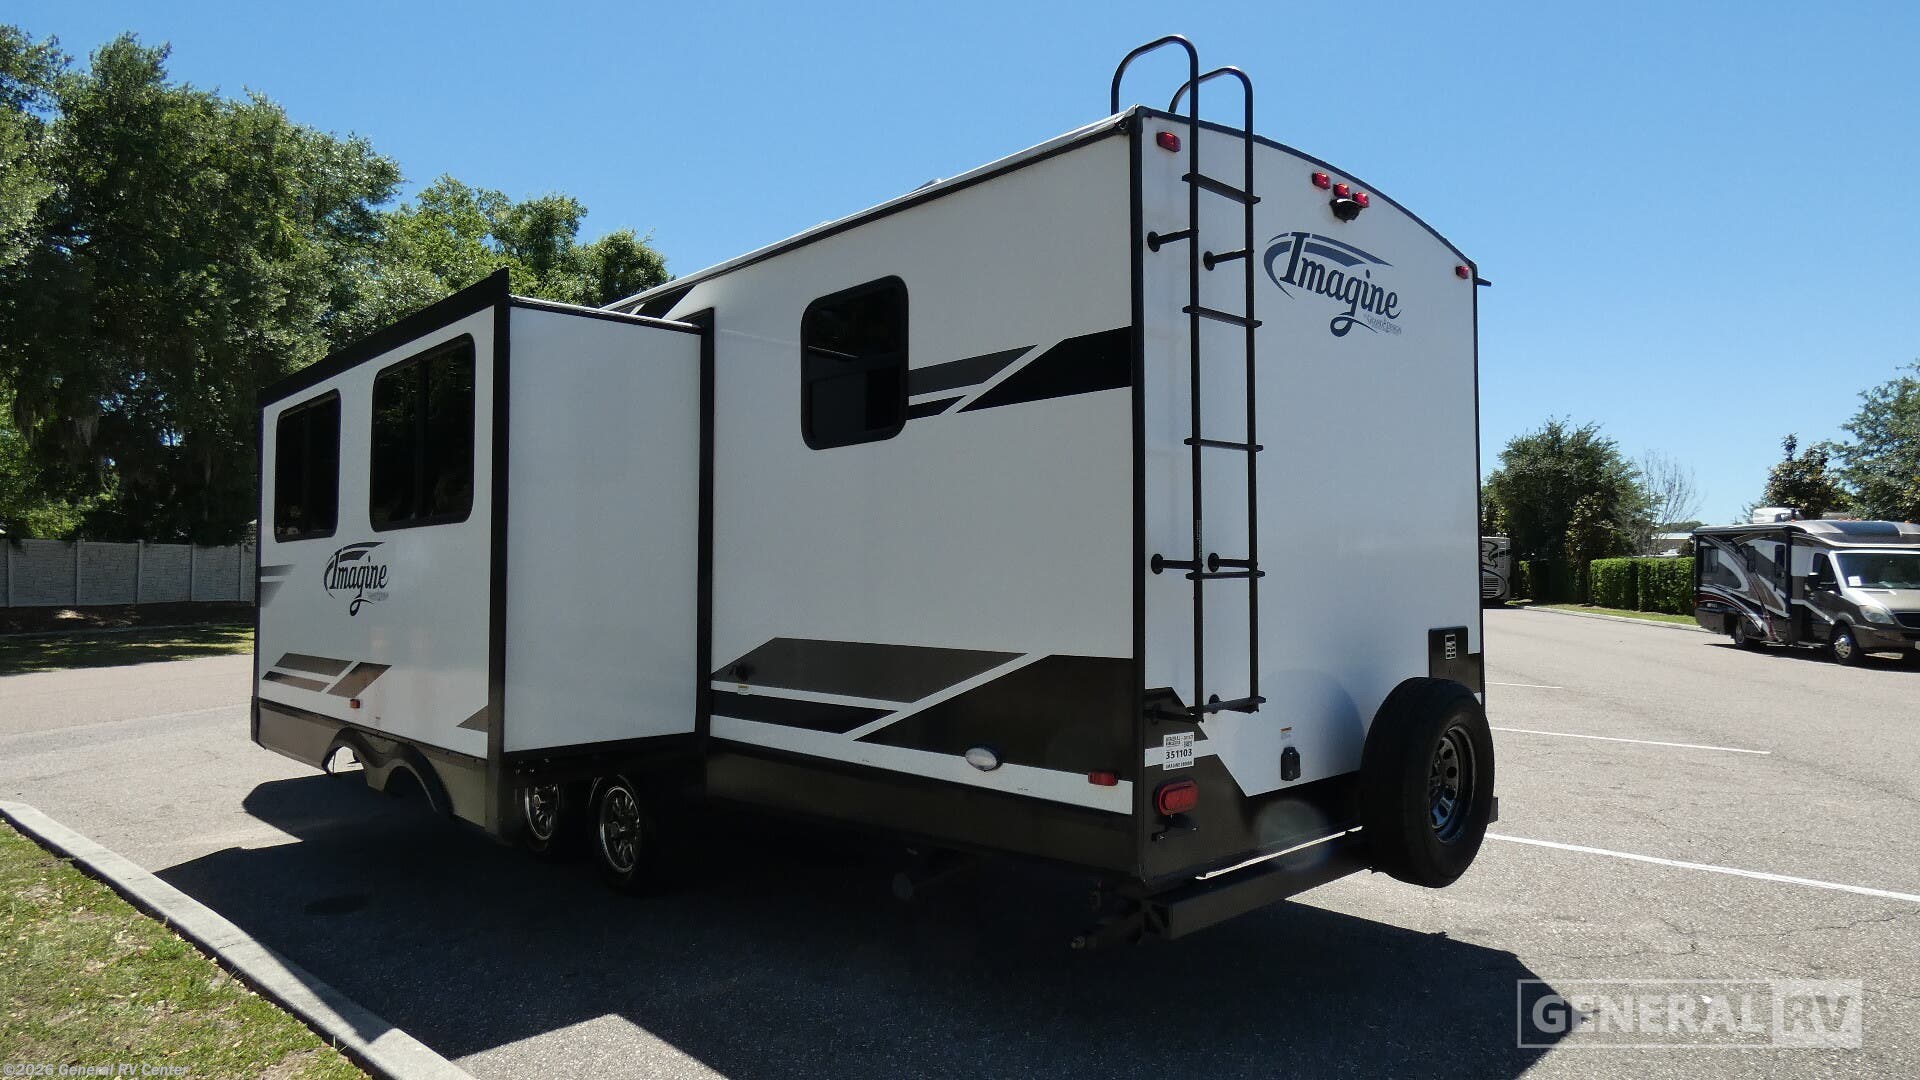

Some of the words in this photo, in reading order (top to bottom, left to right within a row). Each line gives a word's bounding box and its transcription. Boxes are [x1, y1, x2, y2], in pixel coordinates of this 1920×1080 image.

[1279, 231, 1402, 338] Imagine
[329, 548, 388, 616] Imagine
[1166, 749, 1192, 759] 351103
